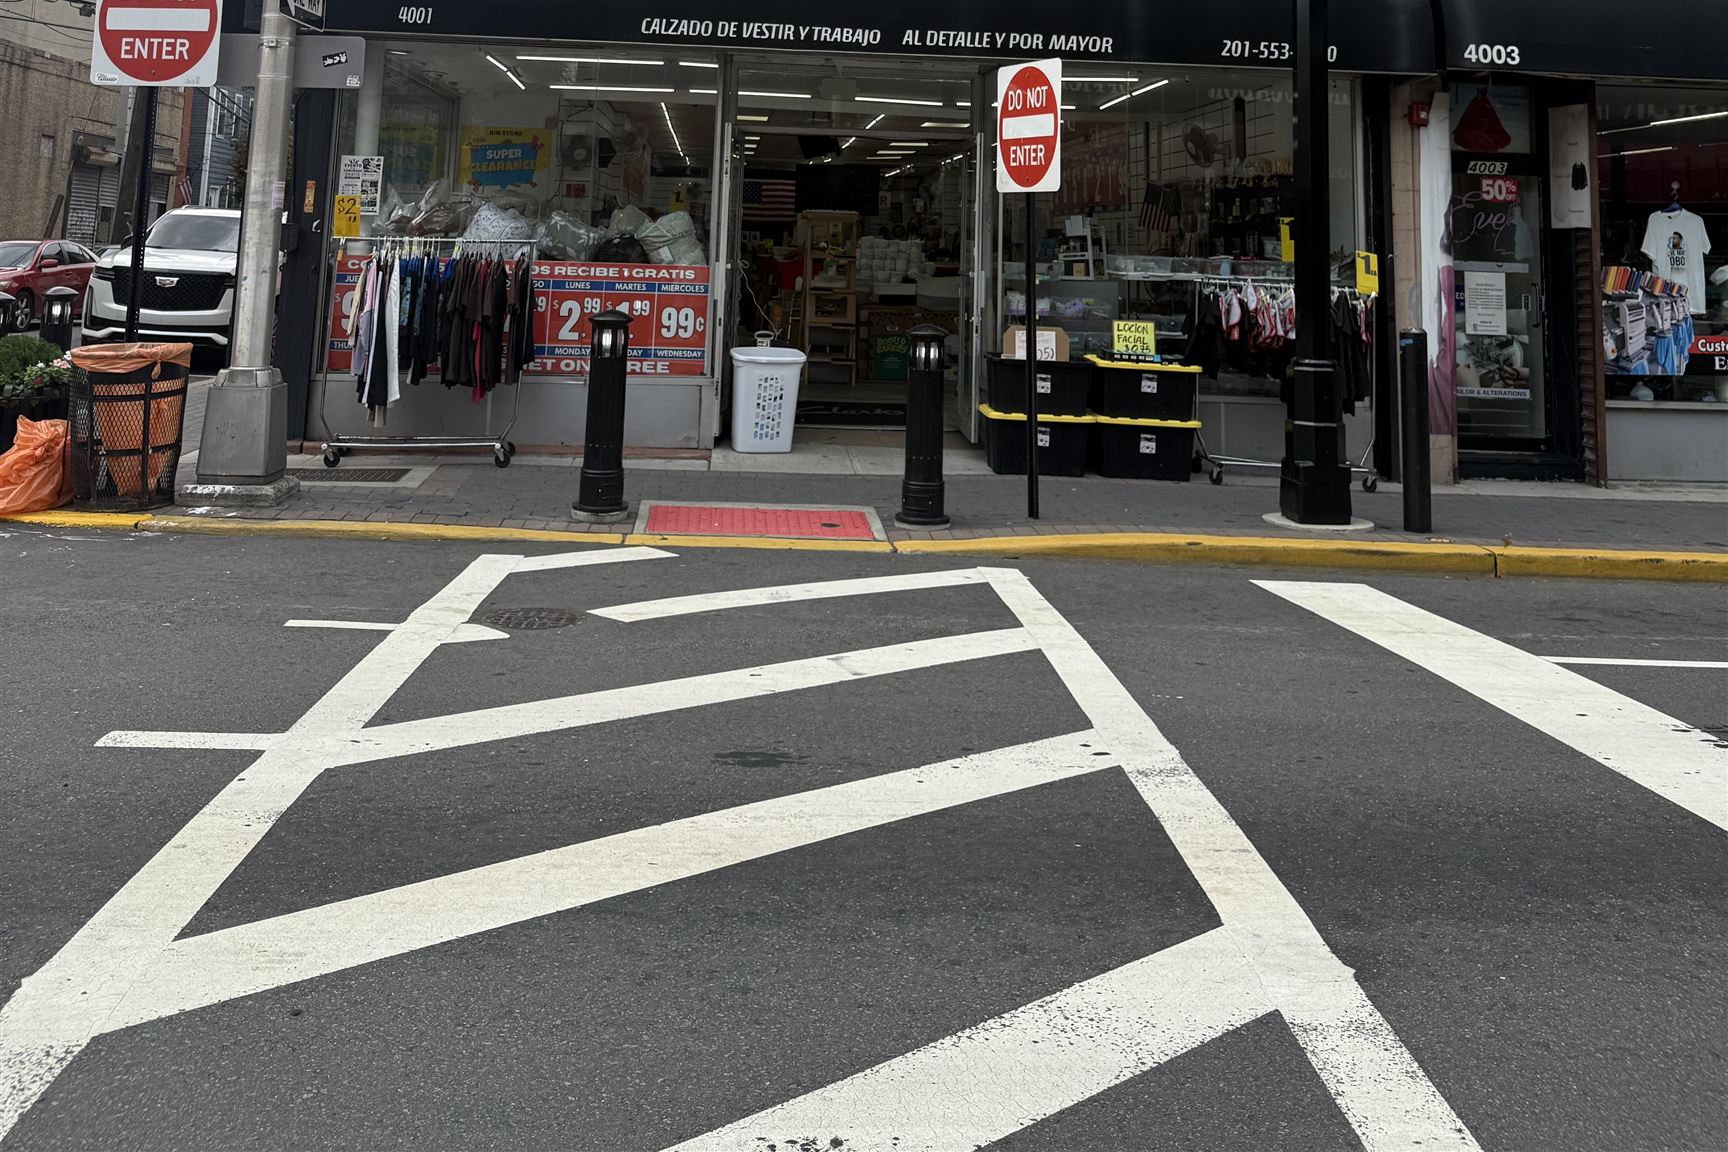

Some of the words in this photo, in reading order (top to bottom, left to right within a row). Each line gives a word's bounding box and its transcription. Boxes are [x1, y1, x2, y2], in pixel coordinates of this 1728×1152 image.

[398, 6, 434, 25] 4001
[640, 17, 714, 38] CALZADO
[717, 21, 739, 40] DE
[742, 22, 796, 42] VESTIR
[799, 26, 810, 42] Y
[811, 26, 882, 47] TRABAJO
[902, 29, 923, 47] AL
[926, 29, 992, 48] DETALLE
[994, 32, 1006, 48] Y
[1008, 33, 1044, 50] POR
[1047, 34, 1114, 54] MAYOR
[119, 37, 190, 62] ENTER
[1463, 43, 1521, 66] 4003
[1008, 89, 1022, 111] DO
[1026, 85, 1048, 109] NOT
[486, 148, 523, 160] SUPER
[1010, 144, 1045, 167] ENTER
[1468, 162, 1506, 175] 4003
[1481, 179, 1517, 201] 50%
[554, 265, 619, 278] RECIBE
[632, 267, 696, 280] GRATIS
[565, 281, 591, 290] LUNES
[615, 283, 647, 292] MARTES
[660, 284, 705, 293] MIERCOLES
[660, 307, 705, 340] 99¢
[1117, 334, 1149, 345] FACIAL
[554, 347, 591, 356] MONDAY
[657, 349, 703, 359] WEDNESDAY
[560, 359, 591, 372] ON
[626, 361, 670, 374] REE
[1714, 356, 1728, 371] E
[1482, 389, 1528, 397] ALTERATIONS
